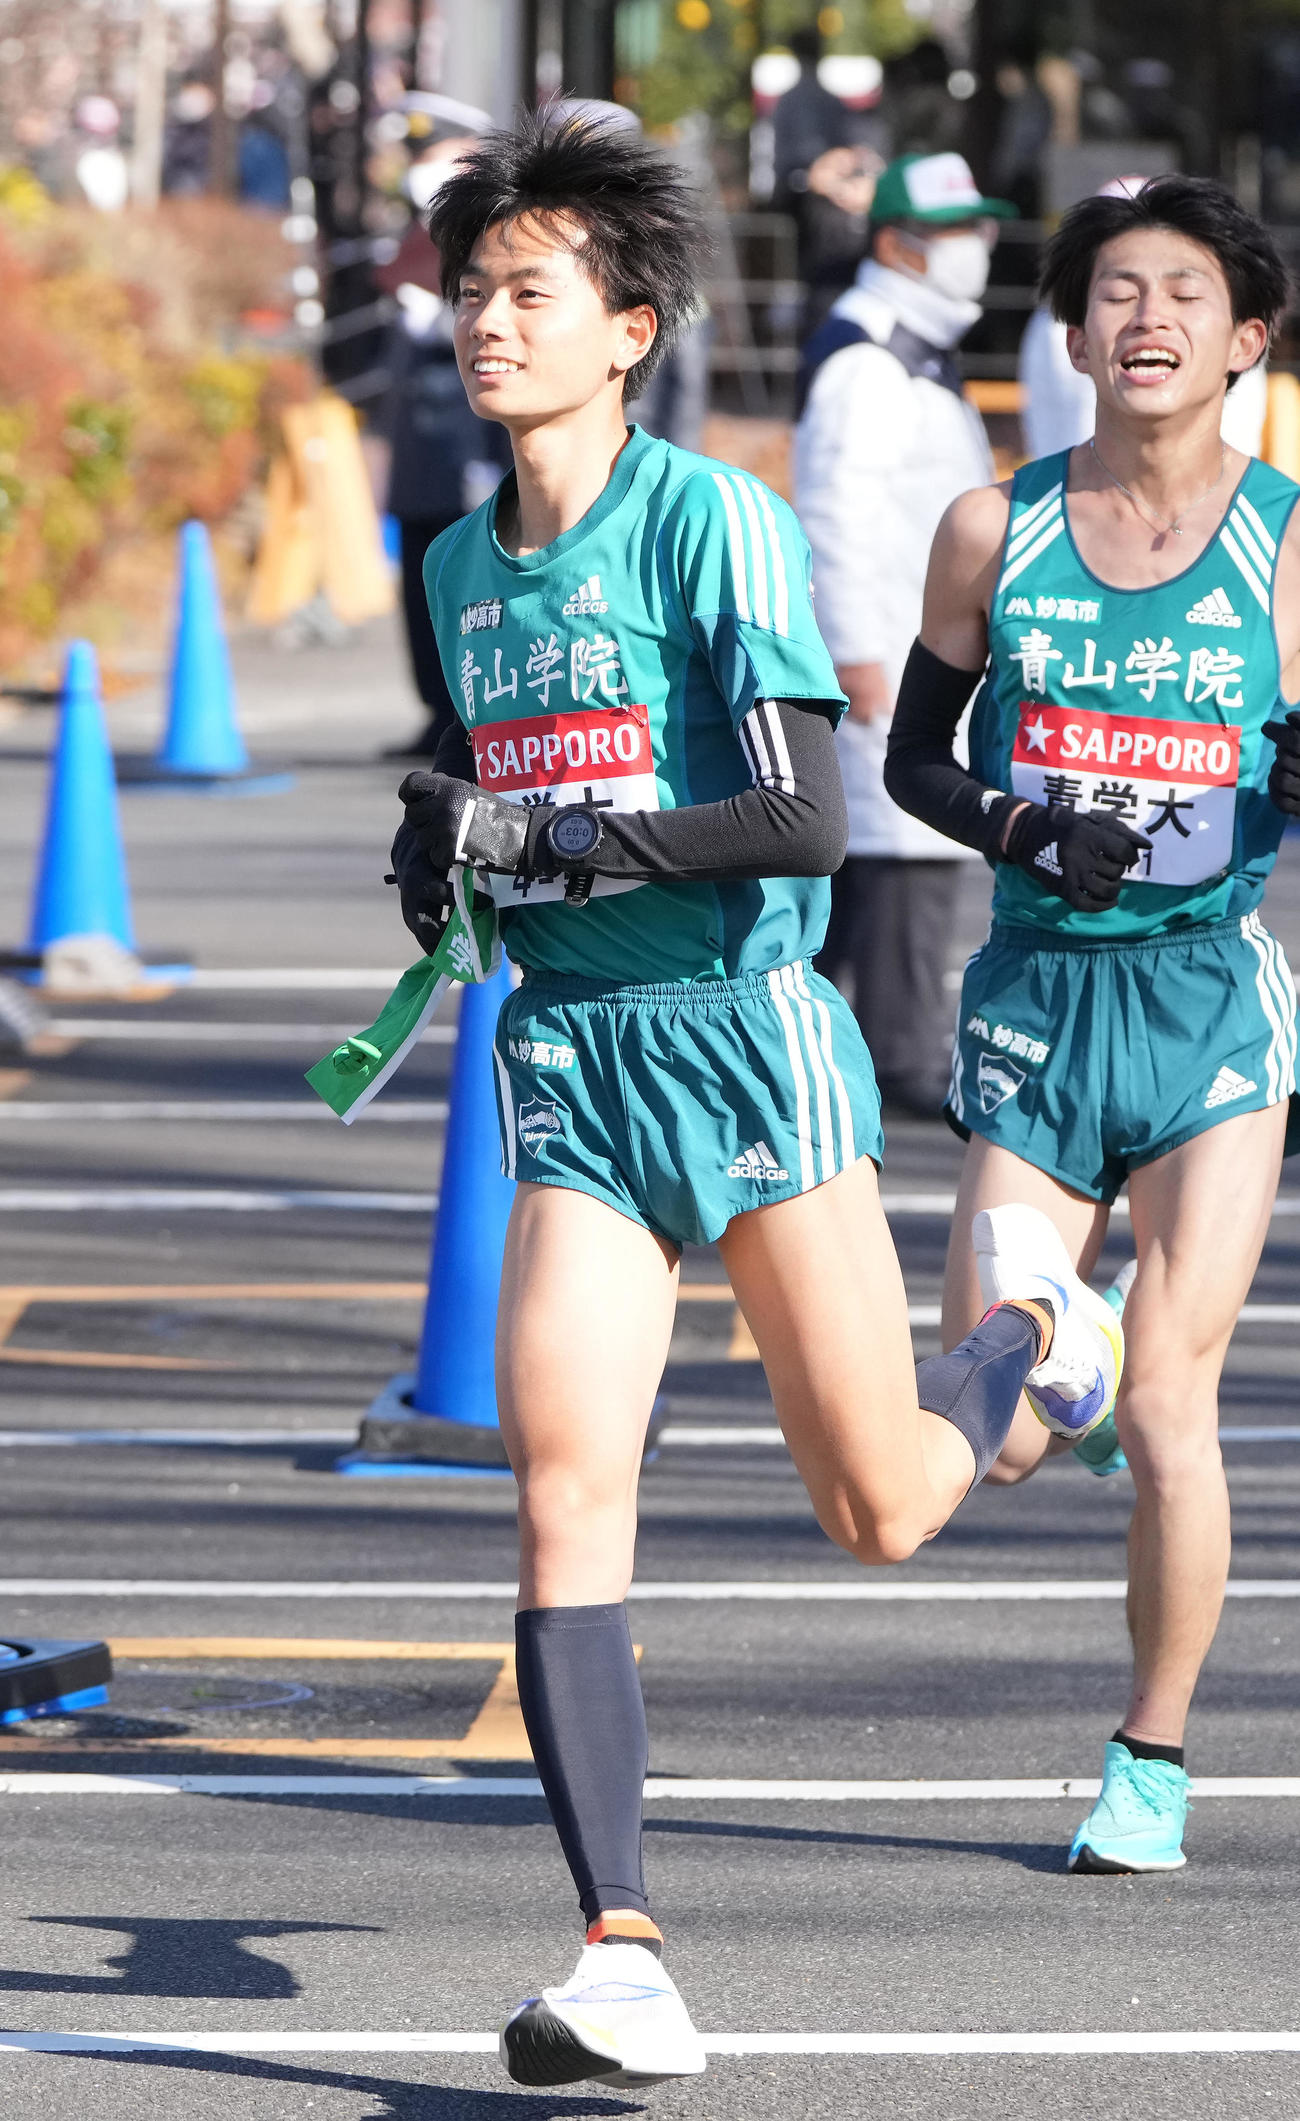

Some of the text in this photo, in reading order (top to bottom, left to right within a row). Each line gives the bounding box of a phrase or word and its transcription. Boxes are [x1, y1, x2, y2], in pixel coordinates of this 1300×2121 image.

[466, 603, 502, 630] 妙高市
[562, 599, 609, 616] adidas
[1035, 596, 1101, 623] 妙高市
[1185, 610, 1243, 629] adidas
[460, 633, 630, 721] 青山学院
[1009, 627, 1246, 709] 青山学院
[488, 724, 641, 779] SAPPORO
[1059, 723, 1232, 776] SAPPORO
[1033, 855, 1064, 876] adidas
[518, 1039, 577, 1069] 妙高市
[991, 1023, 1051, 1065] 妙高市
[727, 1163, 790, 1181] adidas
